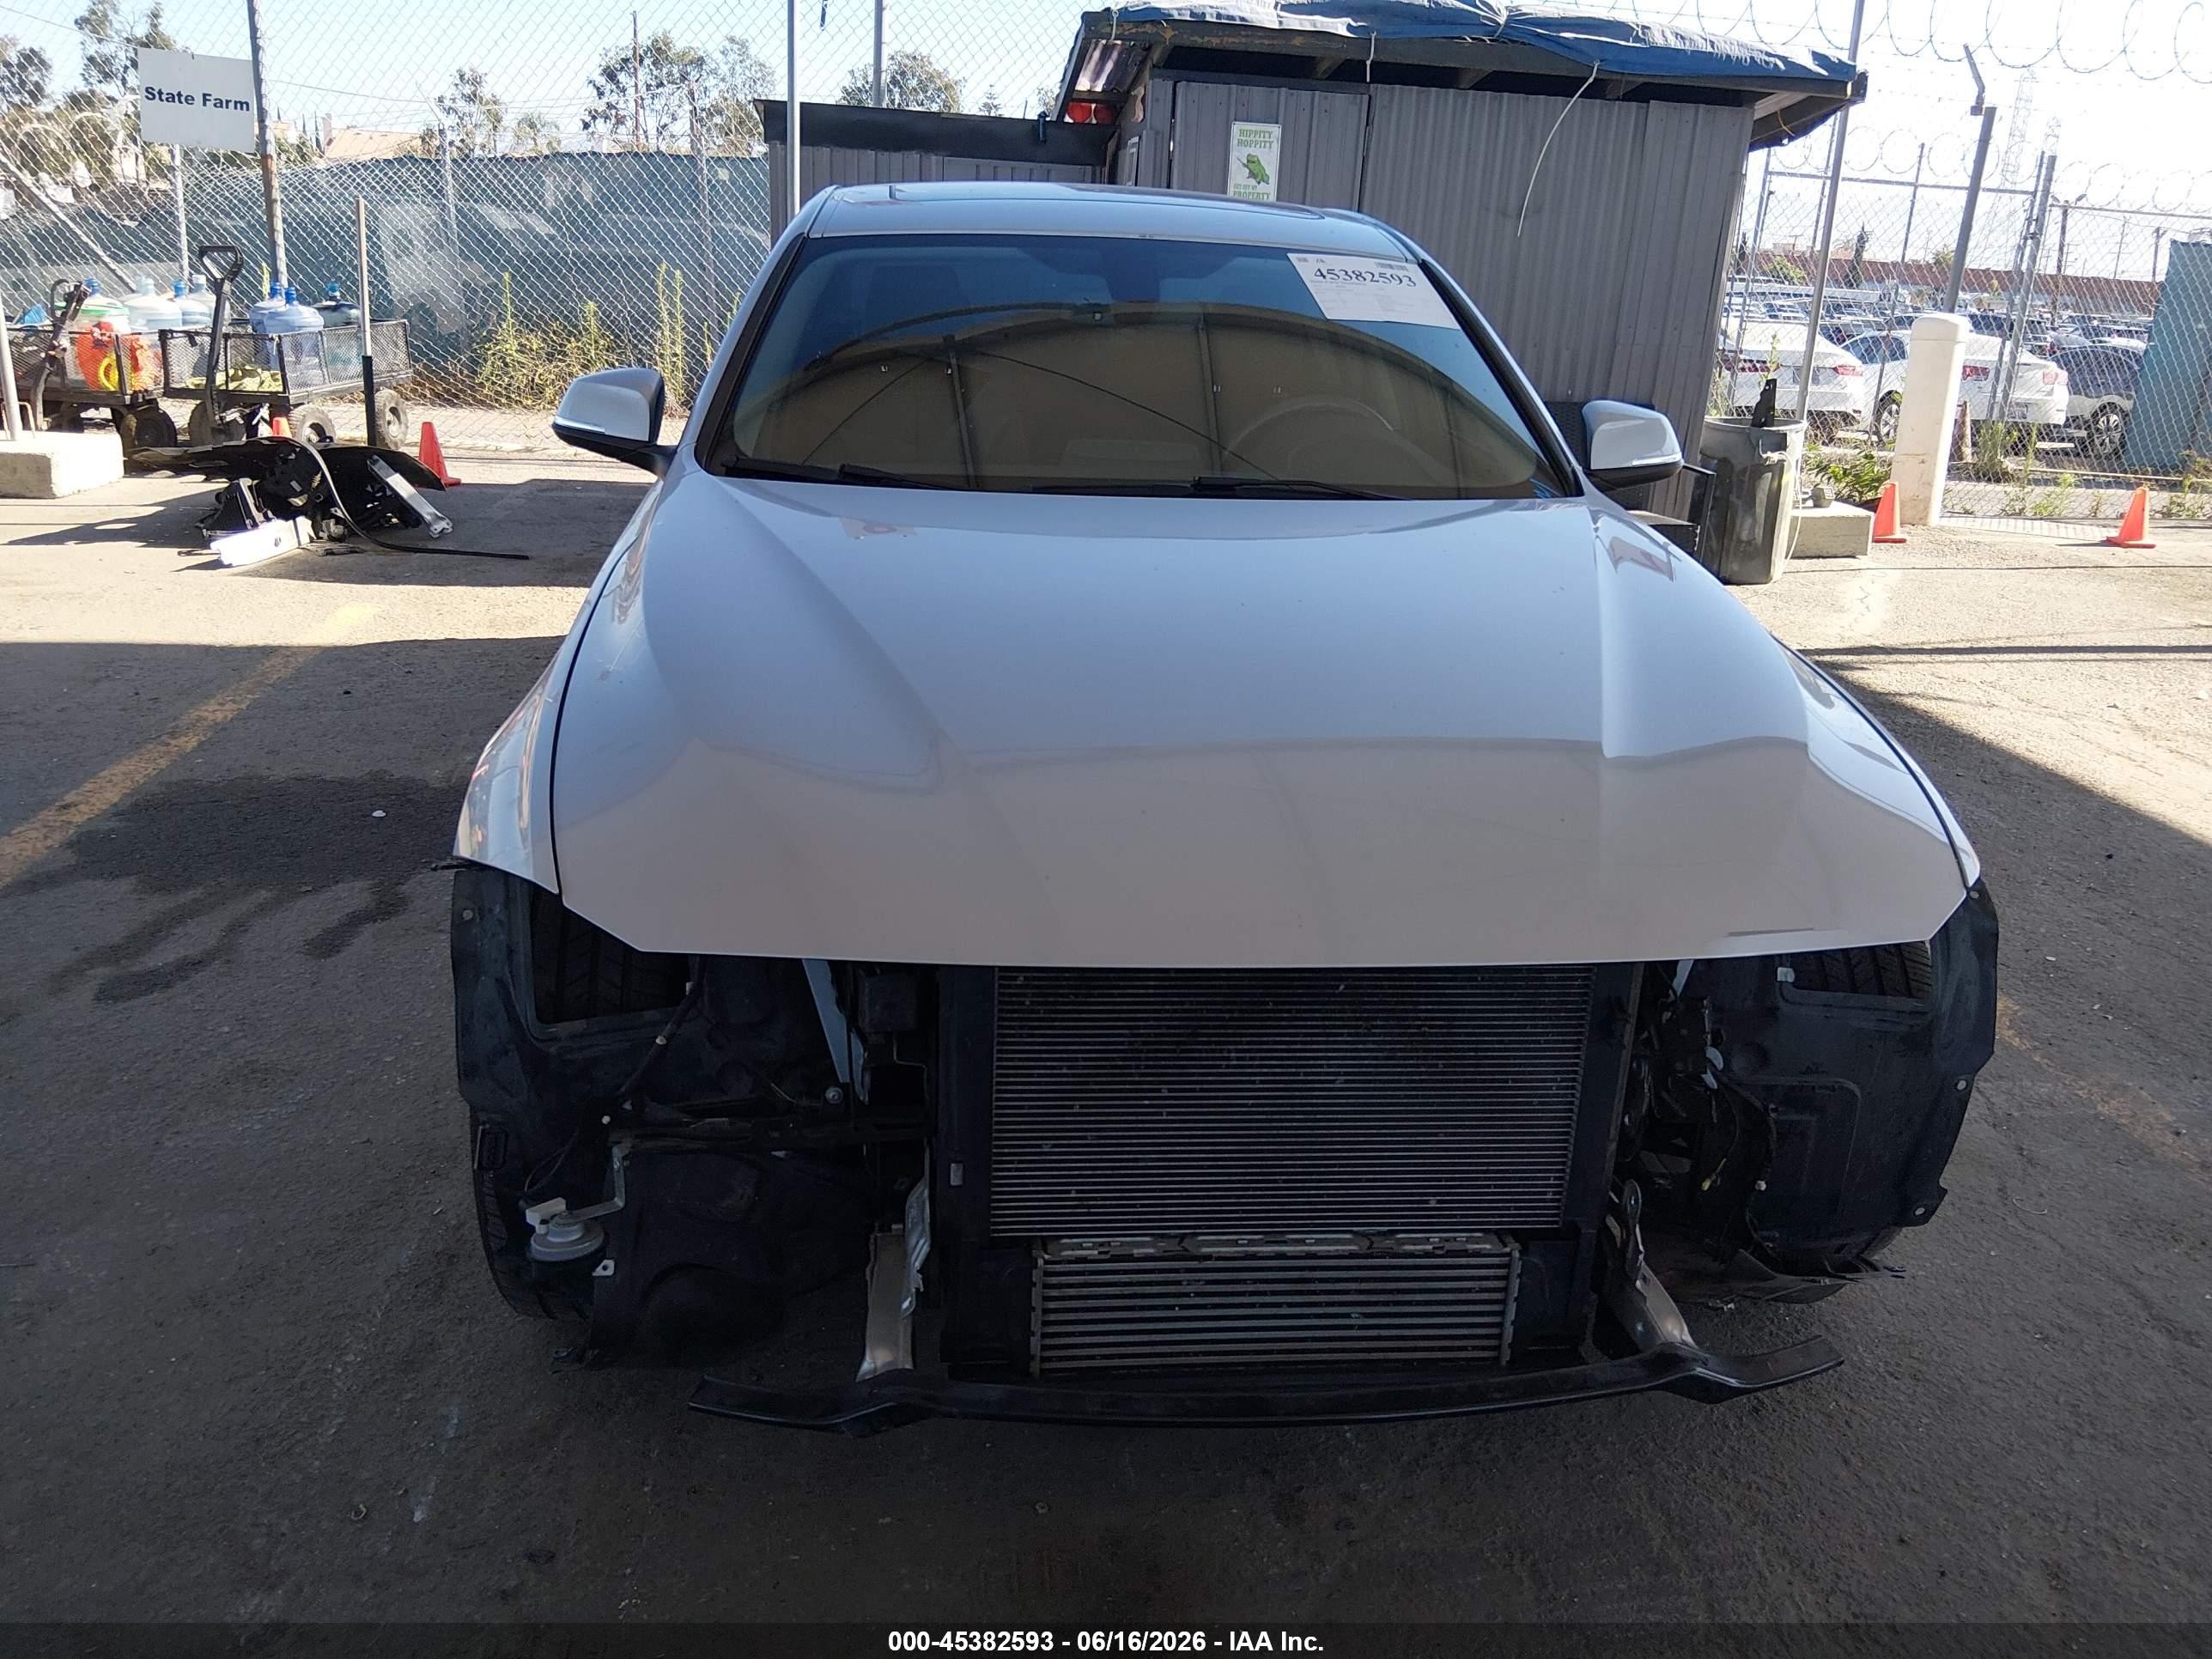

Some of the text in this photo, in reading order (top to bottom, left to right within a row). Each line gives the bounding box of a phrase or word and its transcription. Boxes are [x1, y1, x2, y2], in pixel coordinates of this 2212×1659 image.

[144, 86, 250, 112] State Farm
[1238, 129, 1273, 139] HIPPITY
[1237, 138, 1274, 149] HOPPITY
[1233, 191, 1271, 200] PROPERTY
[1314, 268, 1416, 287] 45382593
